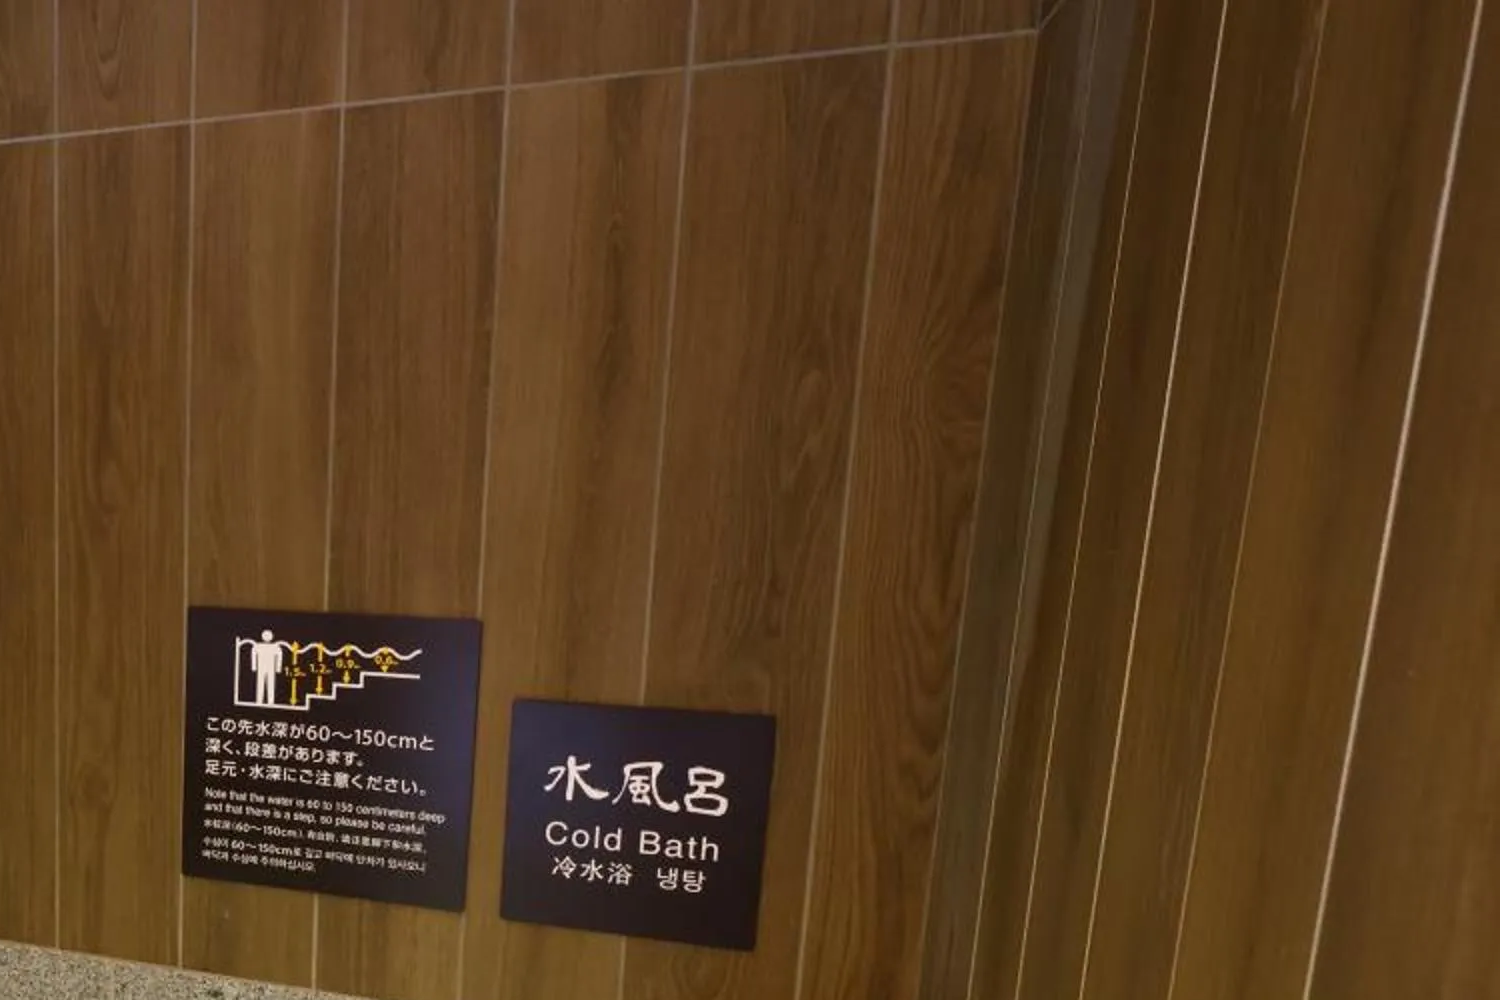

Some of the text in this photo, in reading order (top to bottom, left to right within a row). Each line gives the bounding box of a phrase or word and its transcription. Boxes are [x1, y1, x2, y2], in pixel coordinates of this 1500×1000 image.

[205, 737, 364, 767] 深く、段差があります。
[543, 755, 729, 817] 水風呂
[204, 803, 223, 813] and
[225, 803, 243, 814] that
[335, 815, 369, 829] please
[371, 819, 386, 831] be
[205, 786, 227, 799] Note
[229, 789, 247, 801] that
[249, 792, 265, 803] the
[418, 810, 447, 825] deep
[545, 821, 719, 862] Cold Bath
[551, 855, 633, 886] 冷水浴
[656, 867, 707, 893] 냉탕
